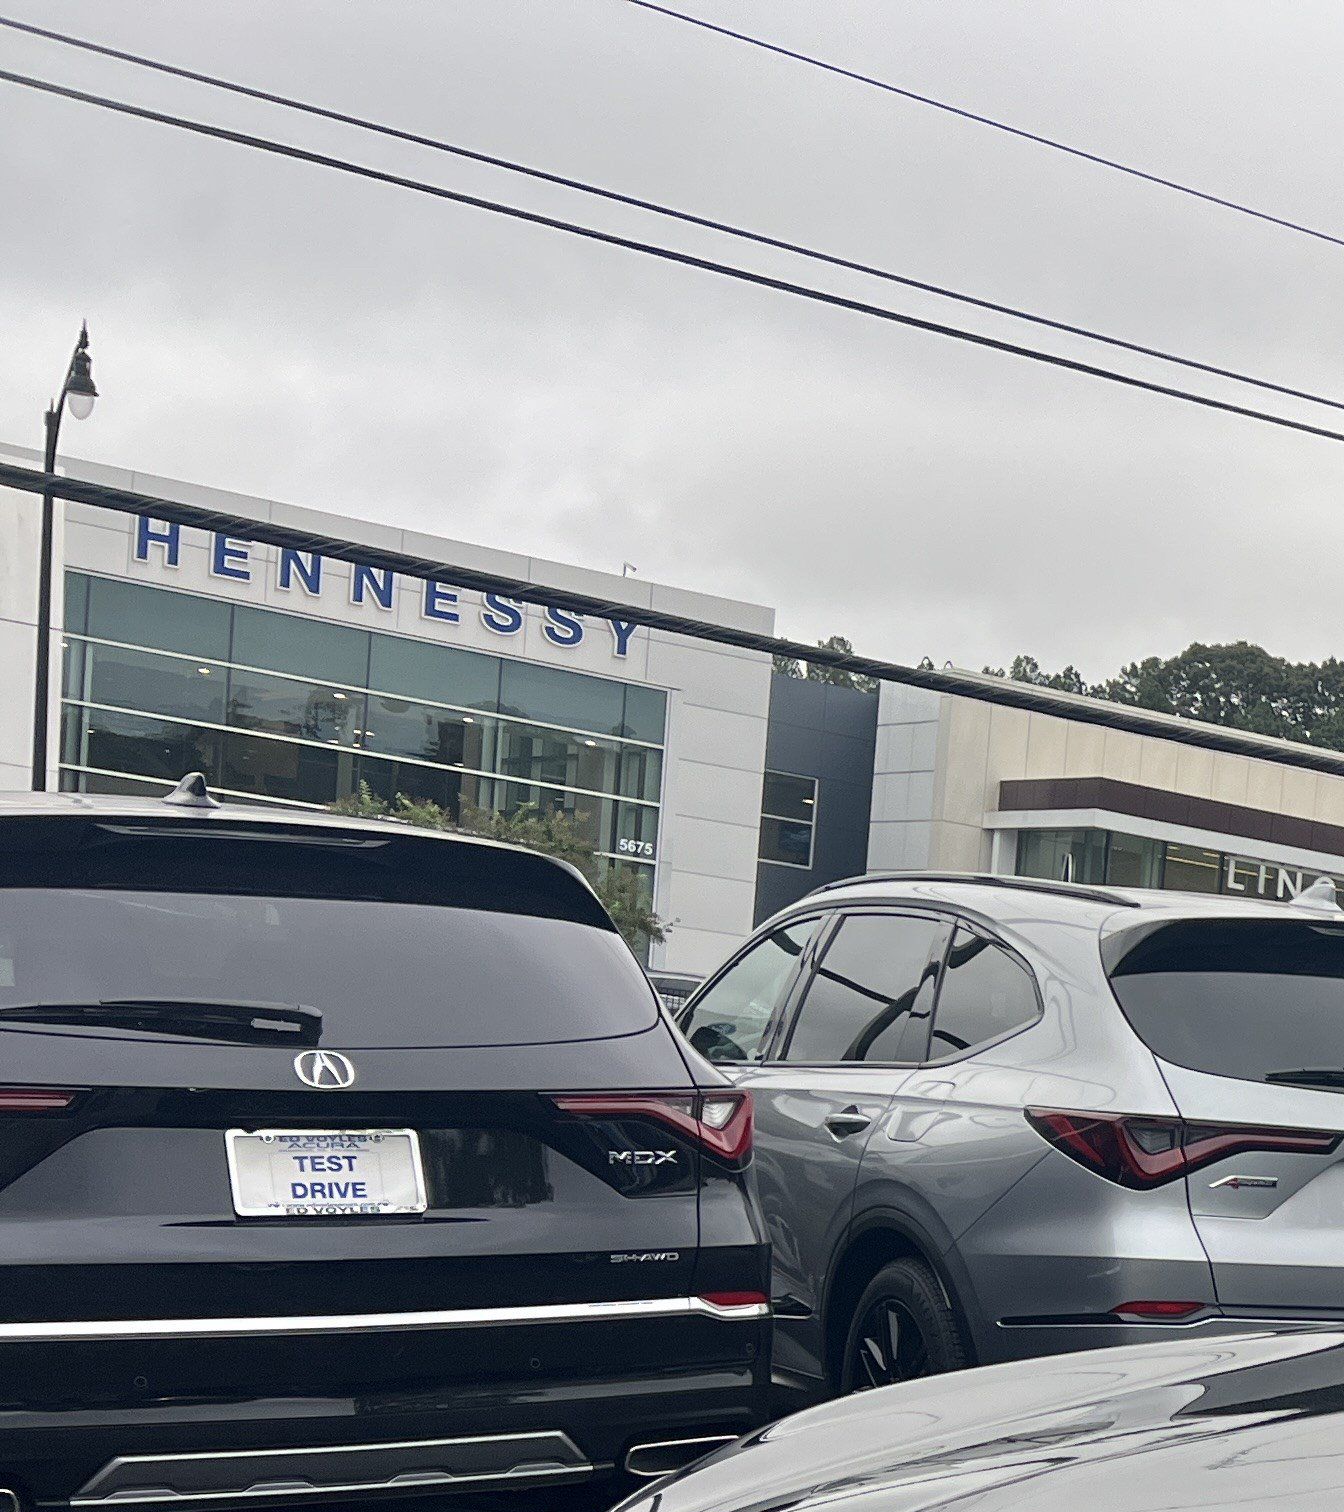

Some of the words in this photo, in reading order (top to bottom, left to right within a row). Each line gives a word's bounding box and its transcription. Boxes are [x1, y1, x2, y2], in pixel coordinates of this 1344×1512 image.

[134, 513, 640, 658] HENNESSY
[619, 838, 653, 856] 5675
[293, 1155, 358, 1173] TEST
[608, 1150, 678, 1165] MDX
[290, 1181, 368, 1200] DRIVE
